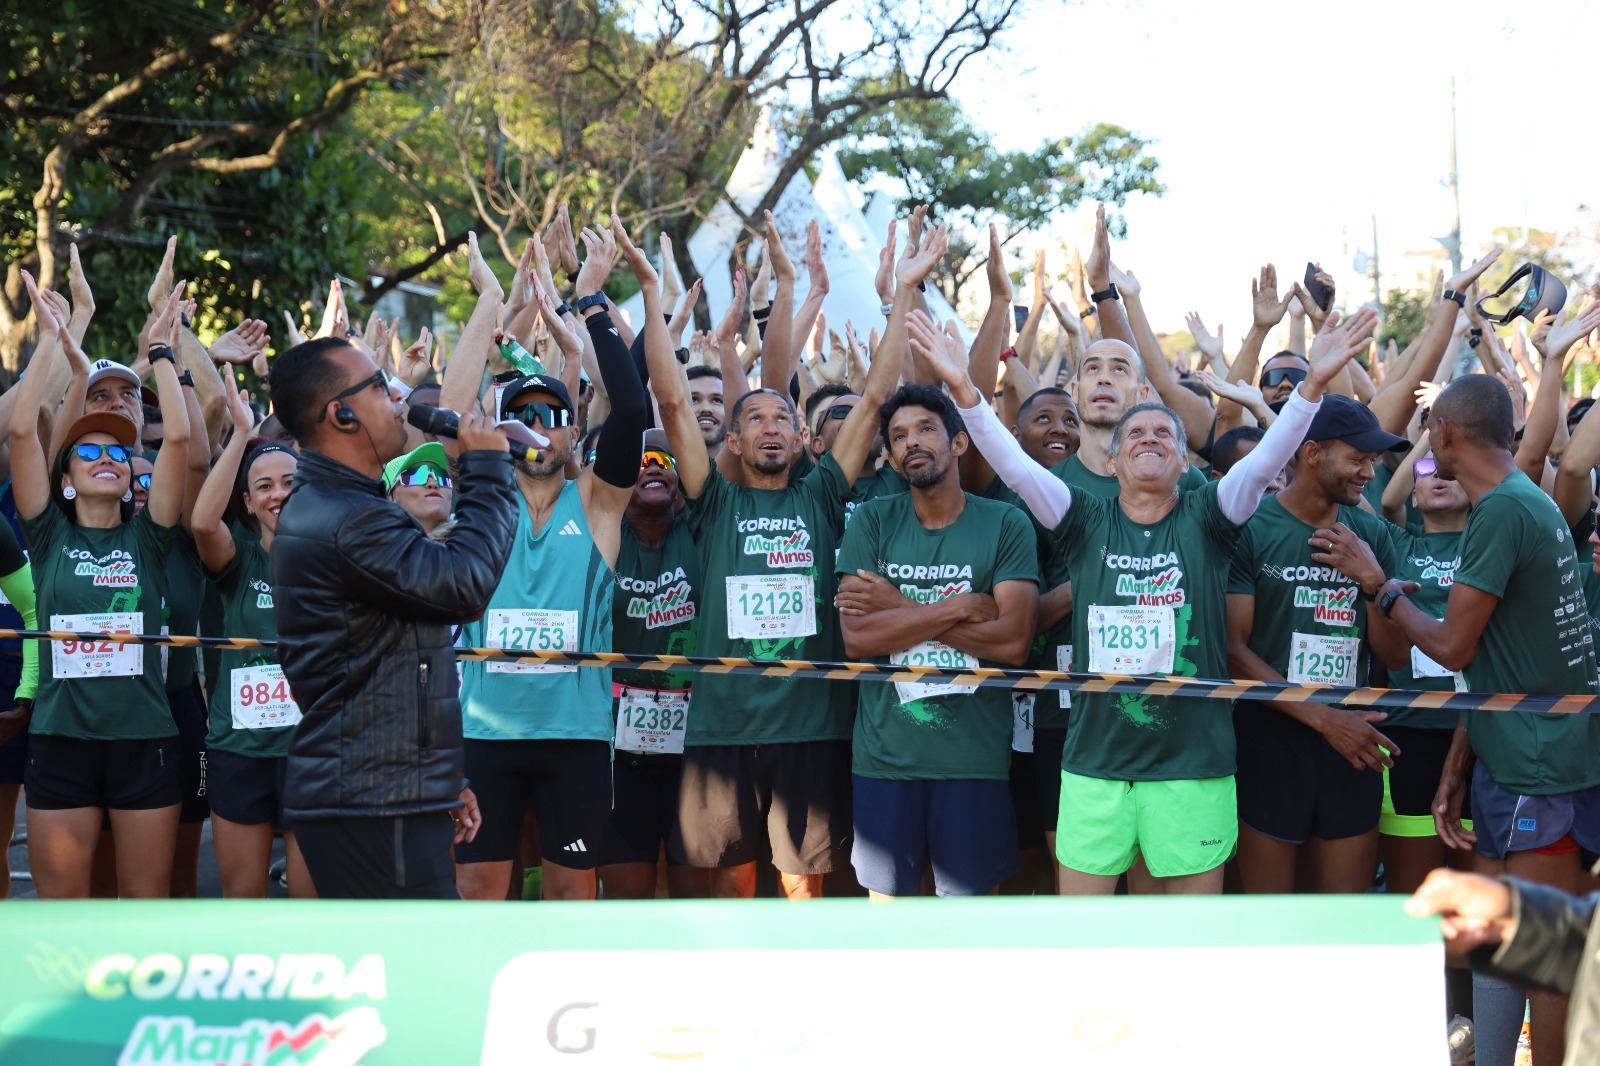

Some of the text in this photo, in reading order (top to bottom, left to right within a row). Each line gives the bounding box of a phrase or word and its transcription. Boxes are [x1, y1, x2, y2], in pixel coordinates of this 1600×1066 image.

[747, 537, 783, 552] Mart
[77, 563, 110, 575] Mart
[769, 552, 812, 565] Minas
[1107, 552, 1178, 570] CORRIDA
[95, 574, 136, 584] Minas
[620, 566, 687, 594] CORIDA
[887, 564, 973, 579] CORRIDA
[902, 588, 938, 602] Mart
[1119, 577, 1152, 593] Mart
[738, 591, 803, 616] 12128
[1138, 591, 1182, 606] Minas
[648, 604, 693, 626] Minas
[62, 630, 130, 655] 9827
[499, 627, 564, 650] 12753
[1098, 625, 1159, 649] 12831
[901, 649, 966, 668] 12598
[1295, 652, 1351, 678] 12597
[240, 681, 296, 707] 984
[624, 706, 684, 730] 12382
[85, 953, 387, 1000] CORRIDA
[131, 1022, 264, 1063] Mart
